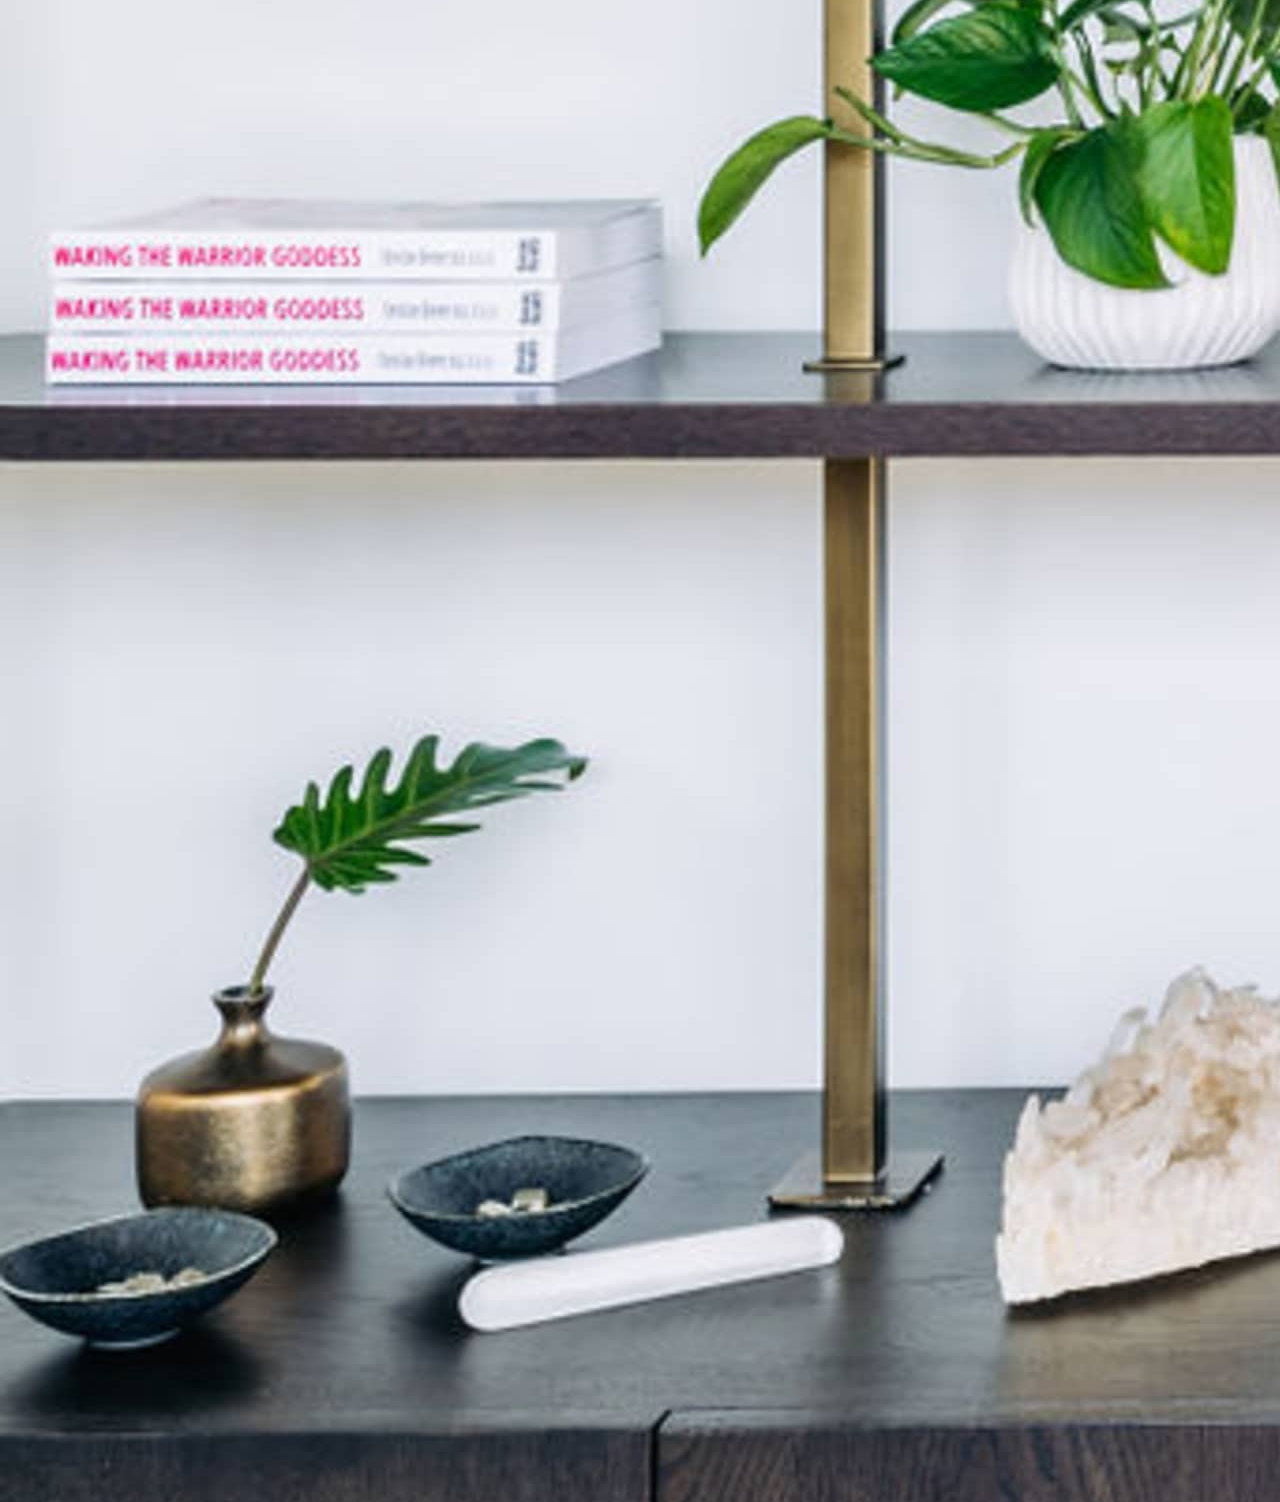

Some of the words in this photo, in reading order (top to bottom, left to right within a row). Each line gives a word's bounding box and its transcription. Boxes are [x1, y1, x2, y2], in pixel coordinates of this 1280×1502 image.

[138, 245, 172, 267] THE
[178, 245, 267, 267] WARRIOR
[271, 245, 361, 267] GODDESS
[139, 297, 173, 321] THE
[179, 297, 267, 321] WARRIOR
[273, 297, 364, 321] GODDESS
[135, 349, 169, 373] THE
[174, 349, 264, 373] WARRIOR
[269, 349, 361, 373] GODDESS
